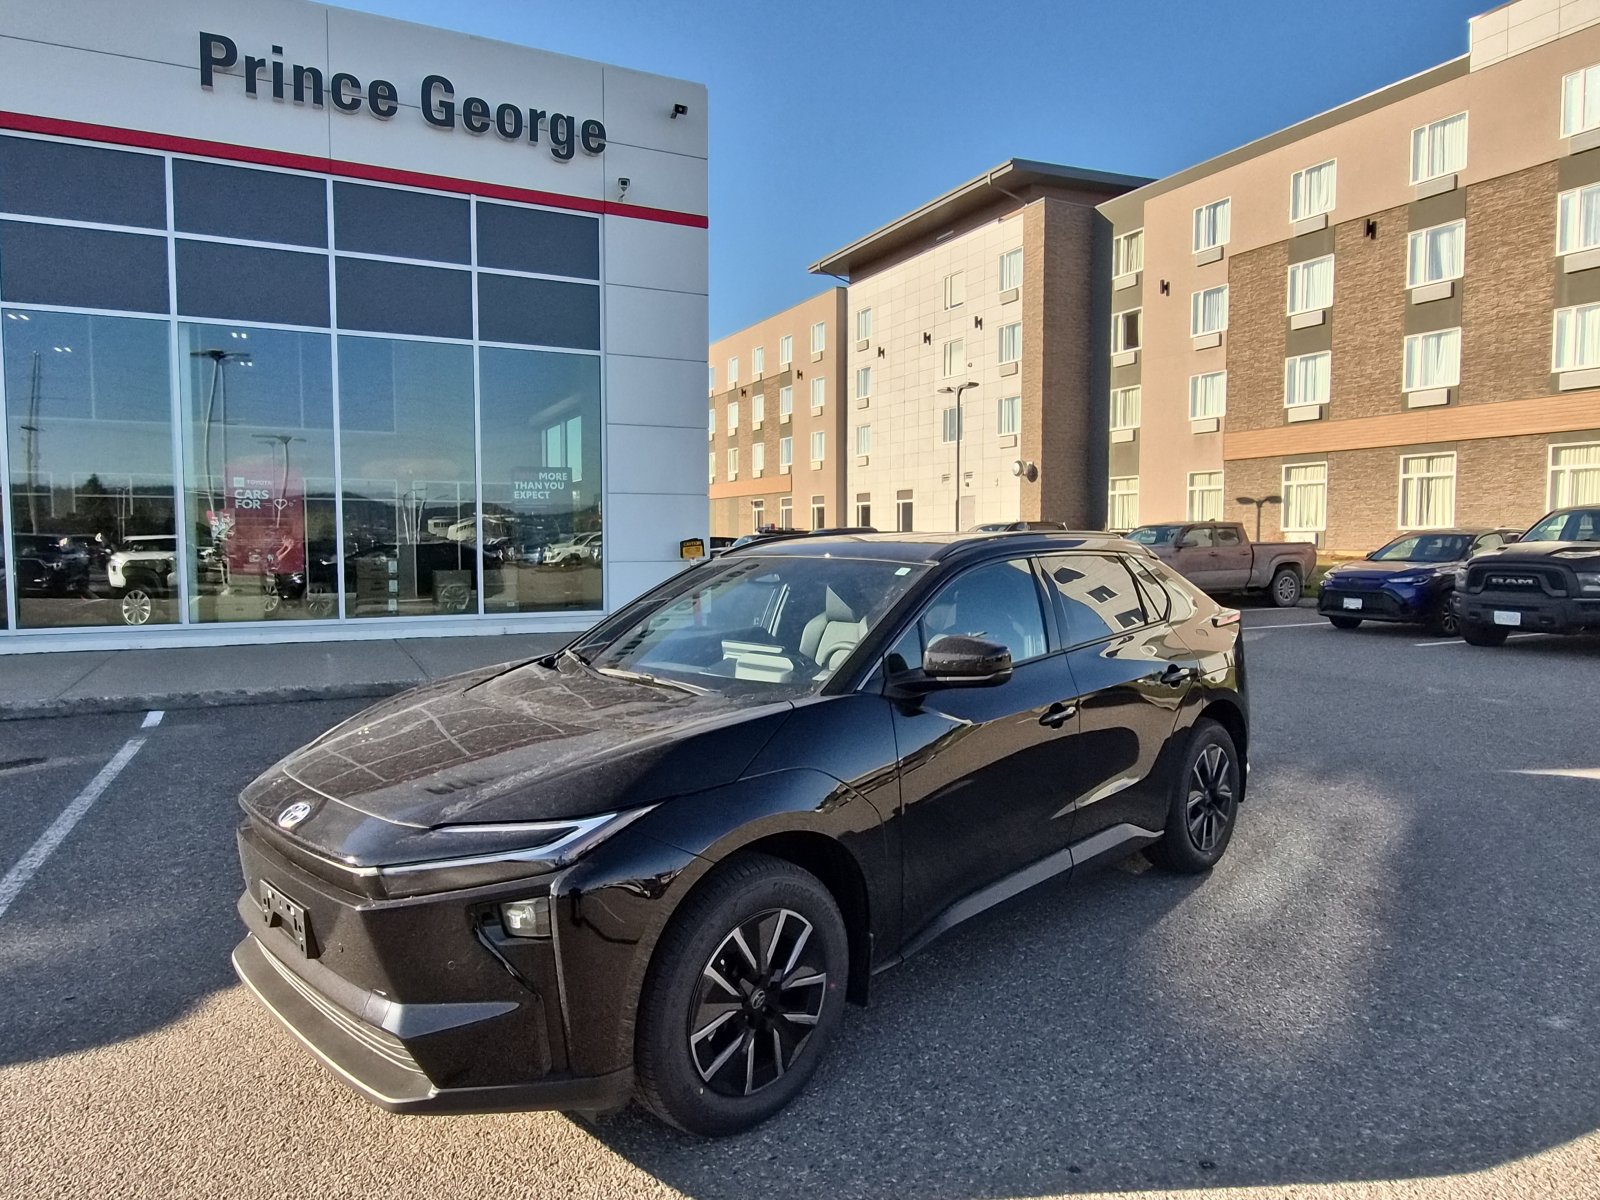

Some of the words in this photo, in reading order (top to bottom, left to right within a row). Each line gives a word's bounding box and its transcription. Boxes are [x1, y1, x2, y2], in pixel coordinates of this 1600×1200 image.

[200, 31, 399, 121] Prince
[420, 74, 607, 162] George
[538, 472, 568, 481] MORE
[514, 481, 542, 490] THAN
[544, 481, 565, 490] YOU
[234, 489, 270, 499] CARS
[514, 491, 550, 499] EXPECT
[235, 499, 261, 509] FOR
